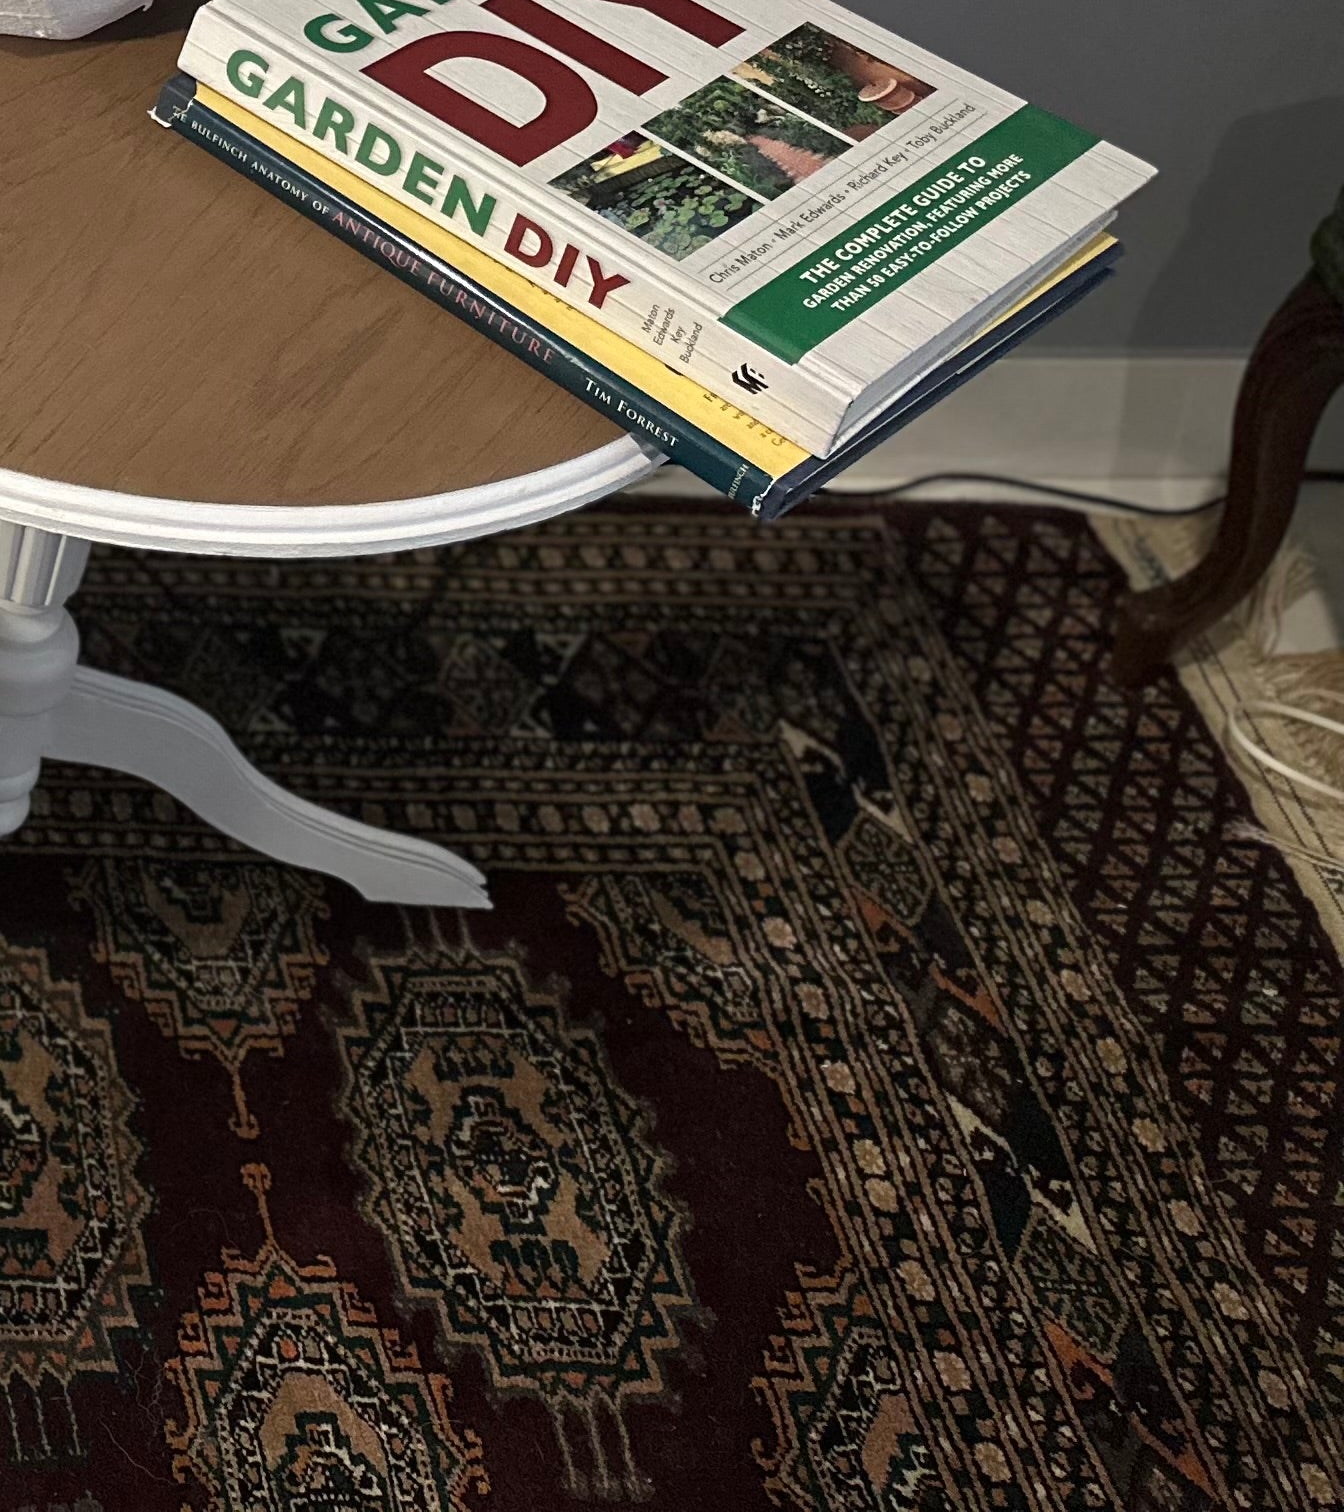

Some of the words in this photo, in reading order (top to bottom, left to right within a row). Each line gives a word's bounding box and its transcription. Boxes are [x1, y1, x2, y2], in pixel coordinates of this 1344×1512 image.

[191, 120, 248, 163] BULFINCH
[251, 160, 309, 202] ANATOMY
[311, 199, 330, 215] OF
[332, 211, 423, 275] ANTIQUE
[427, 269, 556, 365] FURNITURE
[225, 48, 498, 237] GARDEN
[503, 212, 631, 310] DIY
[709, 262, 740, 284] Chris
[735, 242, 774, 267] Maton
[773, 220, 805, 241] Mark
[799, 193, 846, 223] Edwards
[846, 161, 889, 191] Richard
[882, 151, 909, 167] Key
[905, 131, 938, 149] Toby
[929, 102, 976, 135] Buckland
[799, 257, 841, 284] THE
[835, 203, 919, 261] COMPLETE
[912, 171, 965, 208] GUIDE
[957, 156, 986, 175] TO
[802, 271, 856, 309] GARDEN
[853, 220, 934, 276] RENOVATION,
[926, 176, 992, 223] FEATURING
[987, 153, 1025, 179] MORE
[830, 283, 872, 312] THAN
[866, 274, 886, 288] 50
[883, 206, 980, 278] EASY-TO-FOLLOW
[975, 169, 1032, 211] PROJECTS
[641, 304, 660, 333] Maton
[653, 307, 675, 346] Edwards
[671, 326, 687, 344] Key
[679, 321, 703, 364] Buckland
[585, 377, 612, 406] TIM
[616, 399, 680, 447] FORREST
